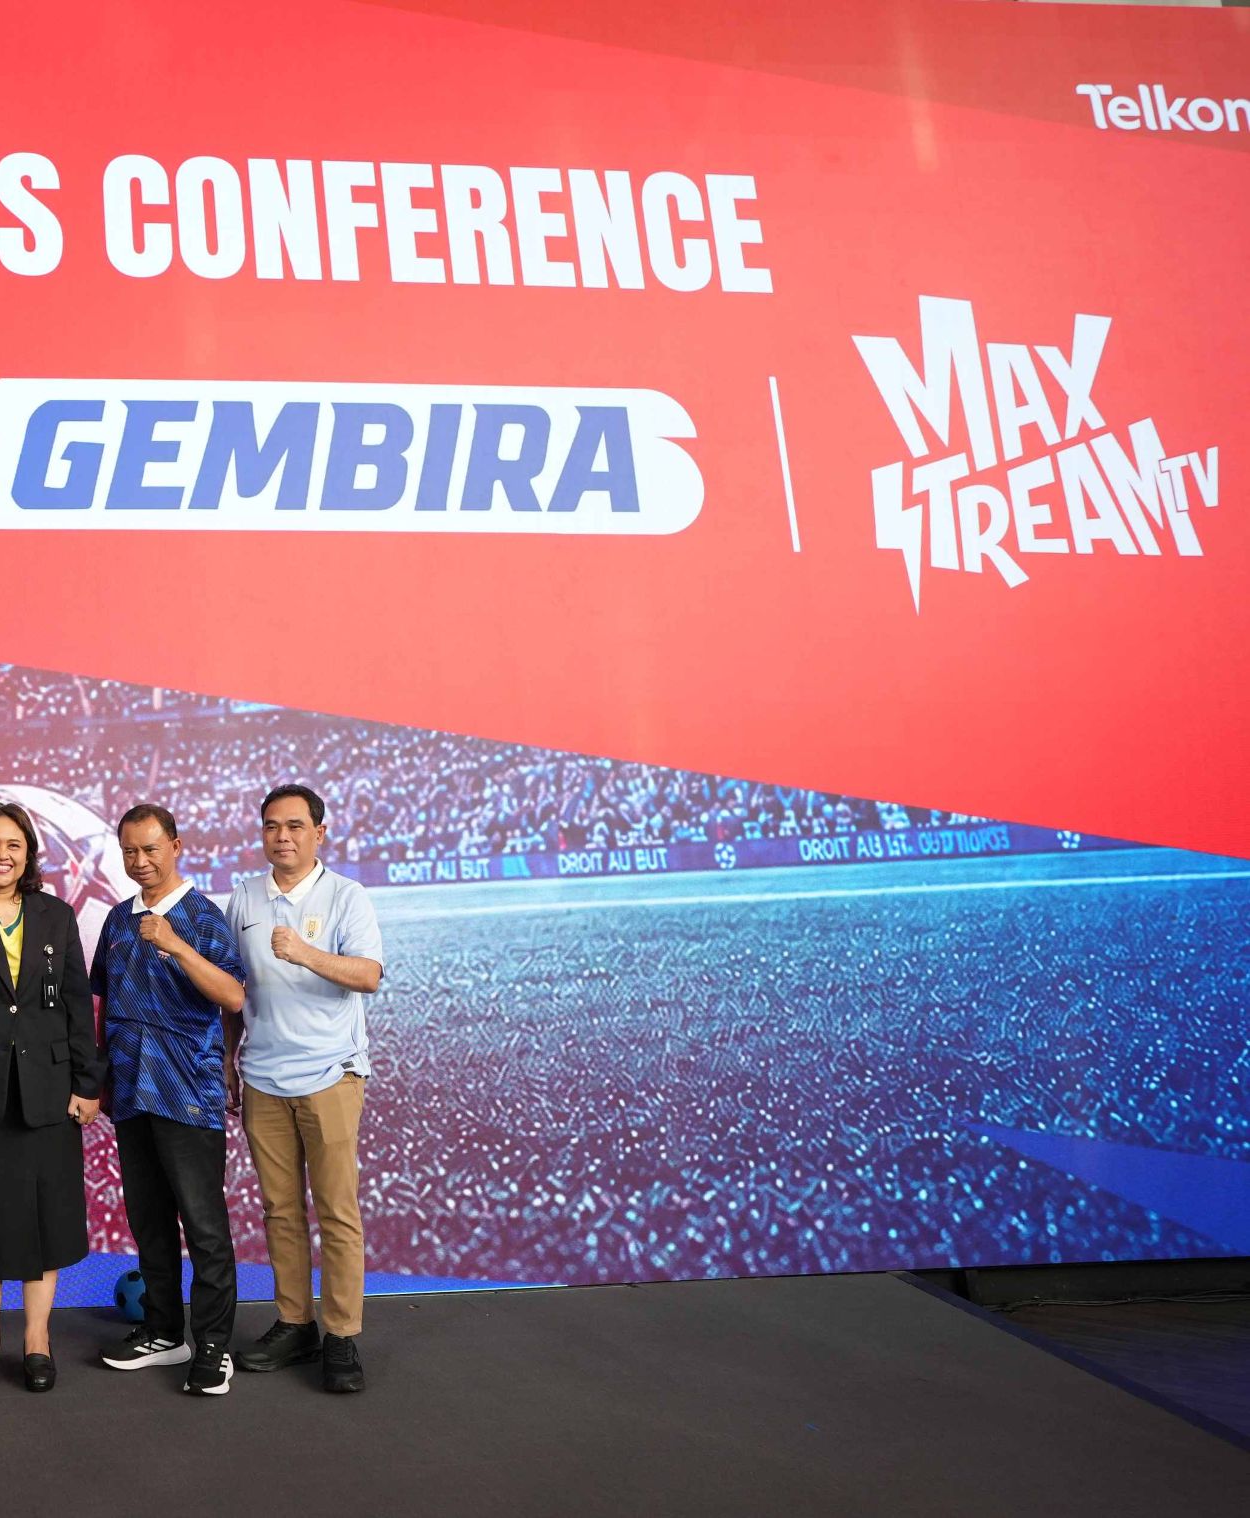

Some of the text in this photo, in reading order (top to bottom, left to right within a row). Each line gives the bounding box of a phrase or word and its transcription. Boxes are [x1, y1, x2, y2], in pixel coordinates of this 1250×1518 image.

[103, 155, 773, 294] CONFERENCE
[851, 294, 1112, 472] MAX
[11, 400, 640, 512] GEMBIRA
